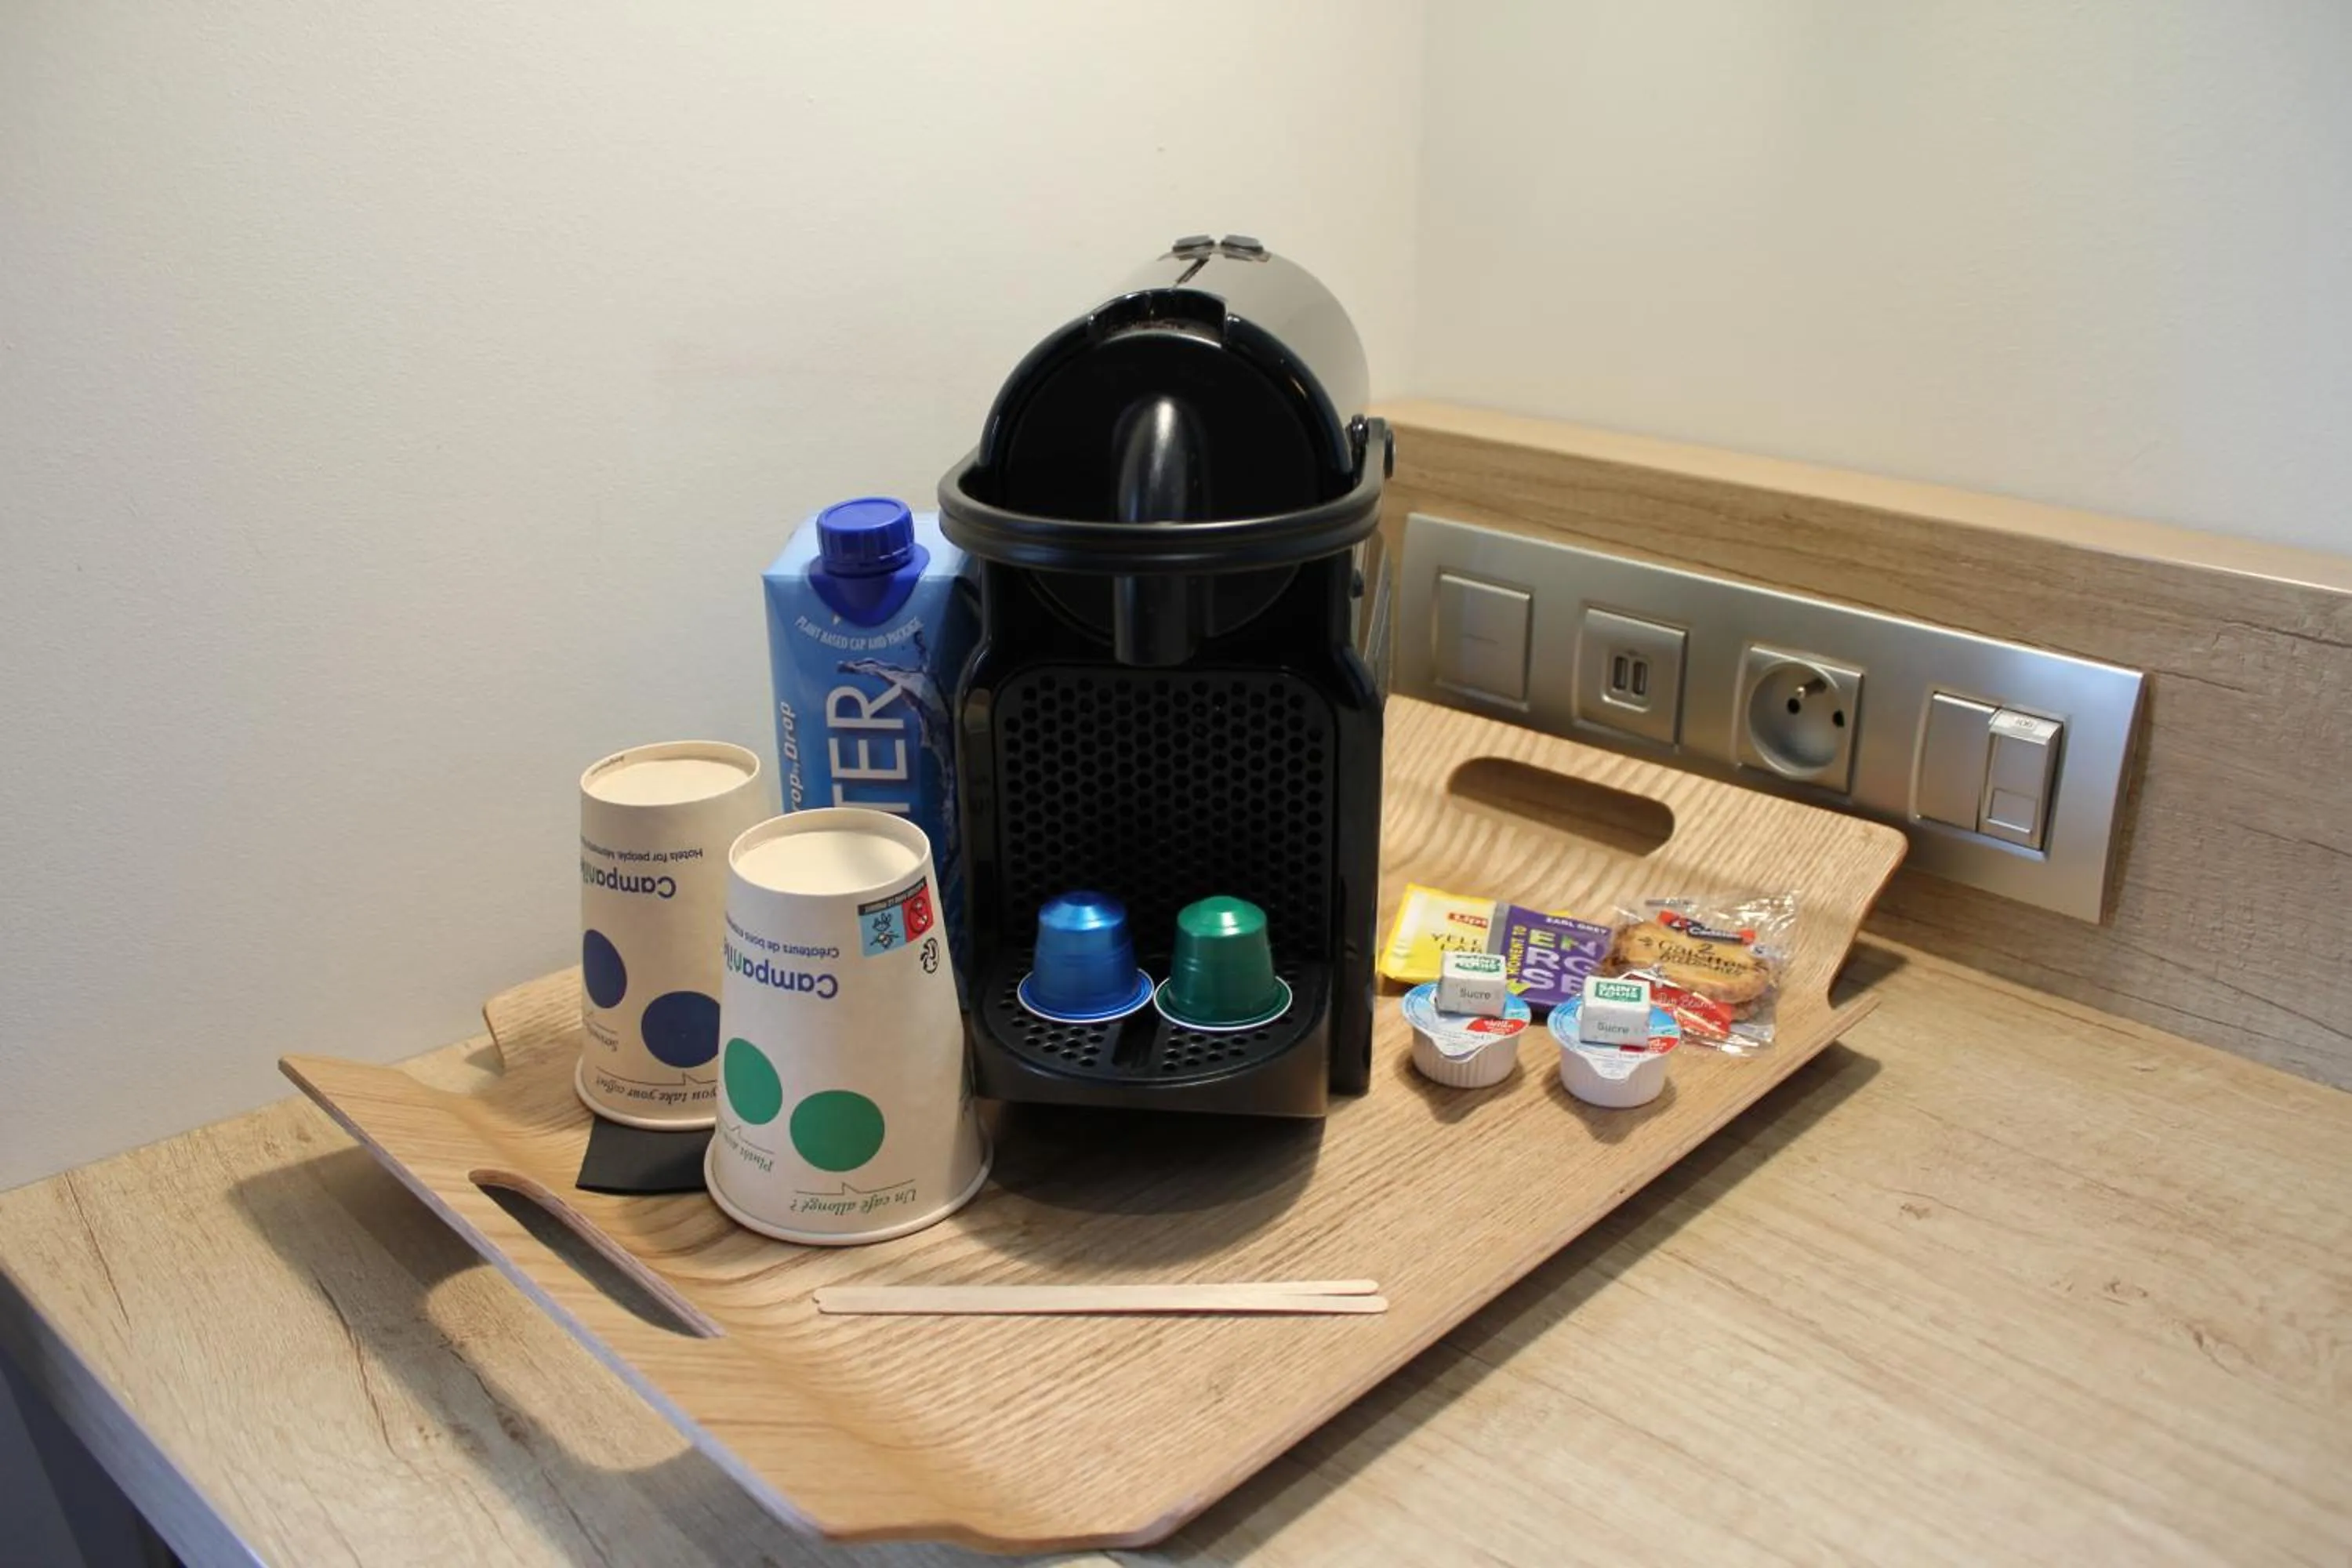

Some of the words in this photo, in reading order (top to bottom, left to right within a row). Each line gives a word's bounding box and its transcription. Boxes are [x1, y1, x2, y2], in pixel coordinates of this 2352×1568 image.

[819, 630, 848, 649] BASED
[850, 637, 867, 650] CAP
[779, 702, 798, 760] Drop
[653, 853, 667, 863] for
[670, 848, 703, 862] Hotels
[580, 856, 677, 900] Campanil
[1545, 916, 1575, 928] EARL
[1576, 923, 1608, 935] GREY
[766, 941, 781, 953] de
[782, 944, 840, 960] Créateurs
[723, 935, 839, 1000] Campanil
[1460, 987, 1491, 1000] Sucre
[1599, 983, 1639, 993] SAINT
[1597, 1022, 1630, 1035] Sucre
[626, 1088, 660, 1101] your
[659, 1092, 688, 1105] take
[858, 1191, 891, 1214] café
[894, 1188, 917, 1203] Un
[800, 1197, 857, 1217] allongé
